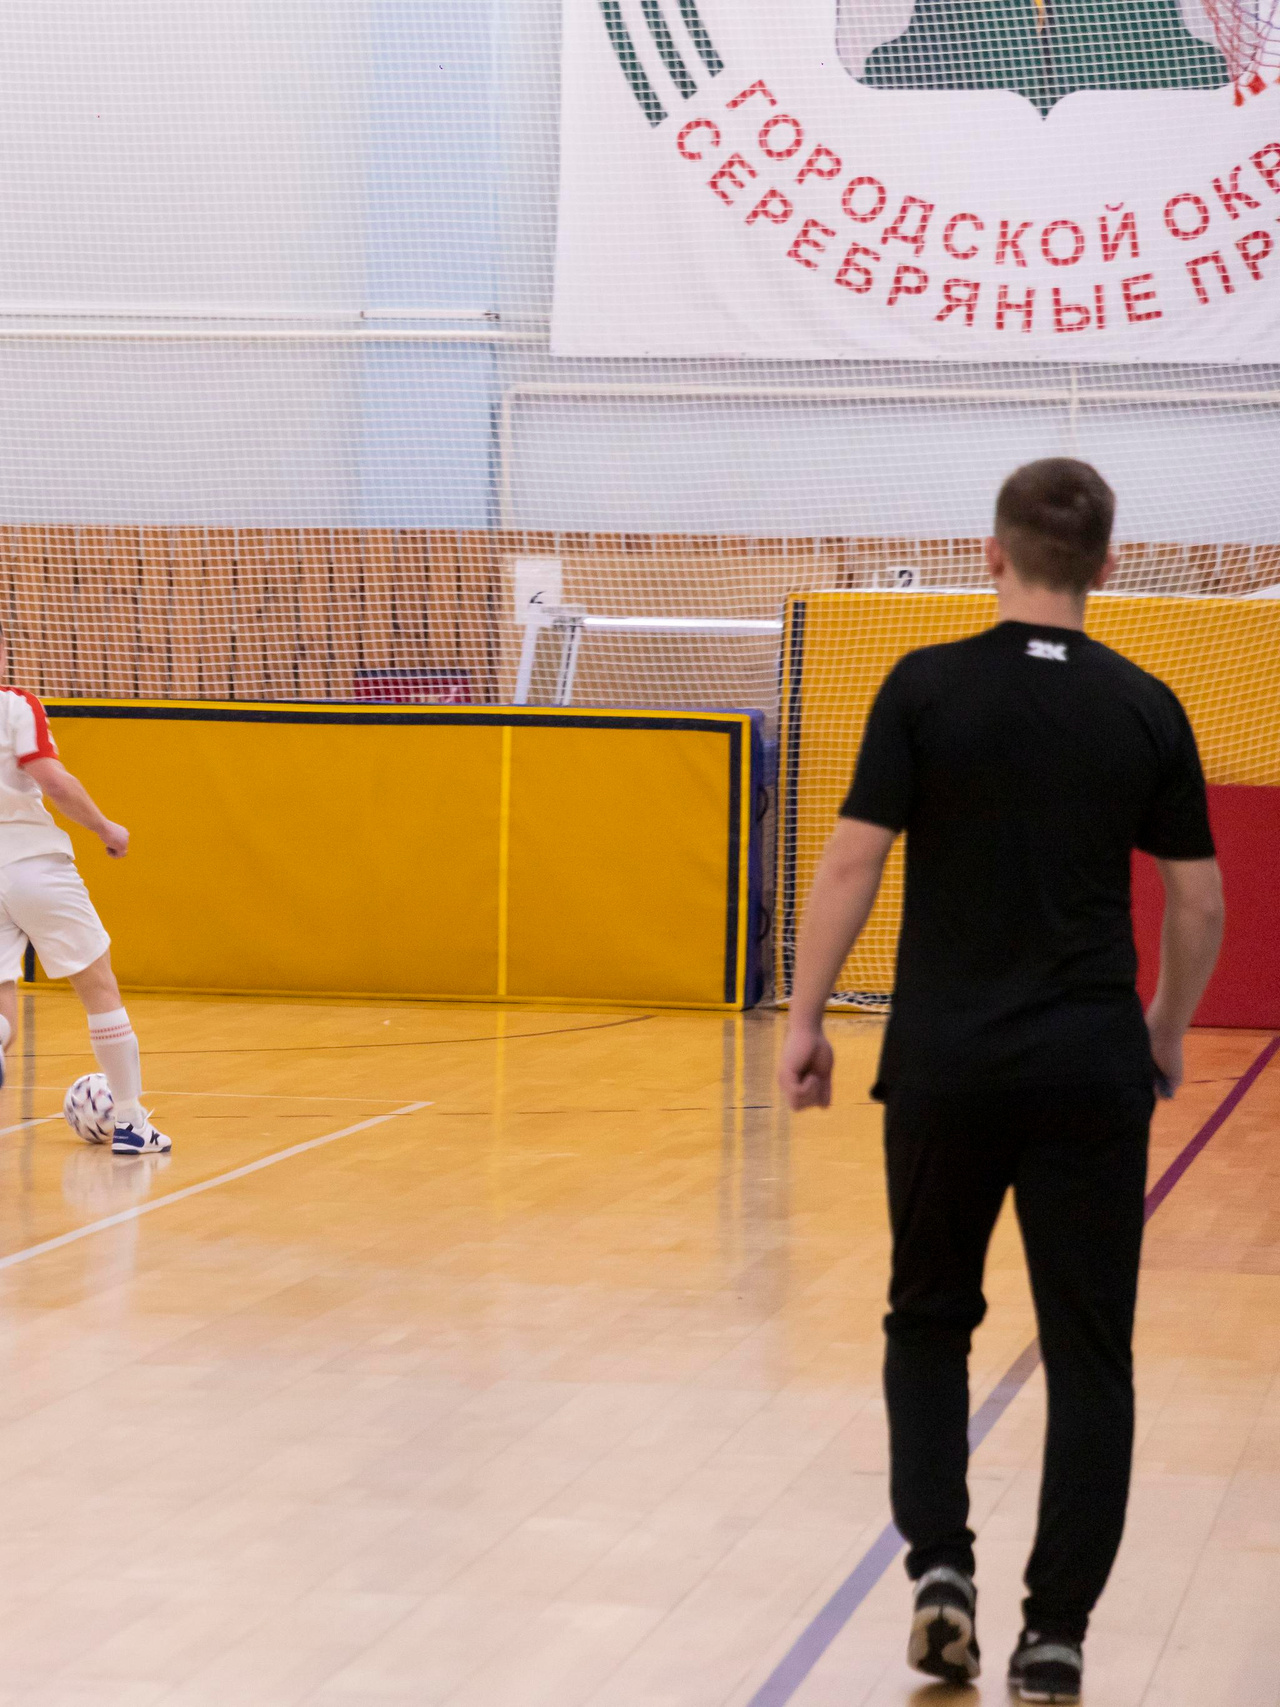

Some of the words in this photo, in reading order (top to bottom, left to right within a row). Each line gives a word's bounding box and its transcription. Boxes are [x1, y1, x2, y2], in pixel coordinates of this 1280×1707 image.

[677, 119, 1163, 334] СЕРЕБРЯНЫЕ
[1184, 215, 1280, 305] ПР
[726, 80, 1140, 267] ГОРОДСКОЙ
